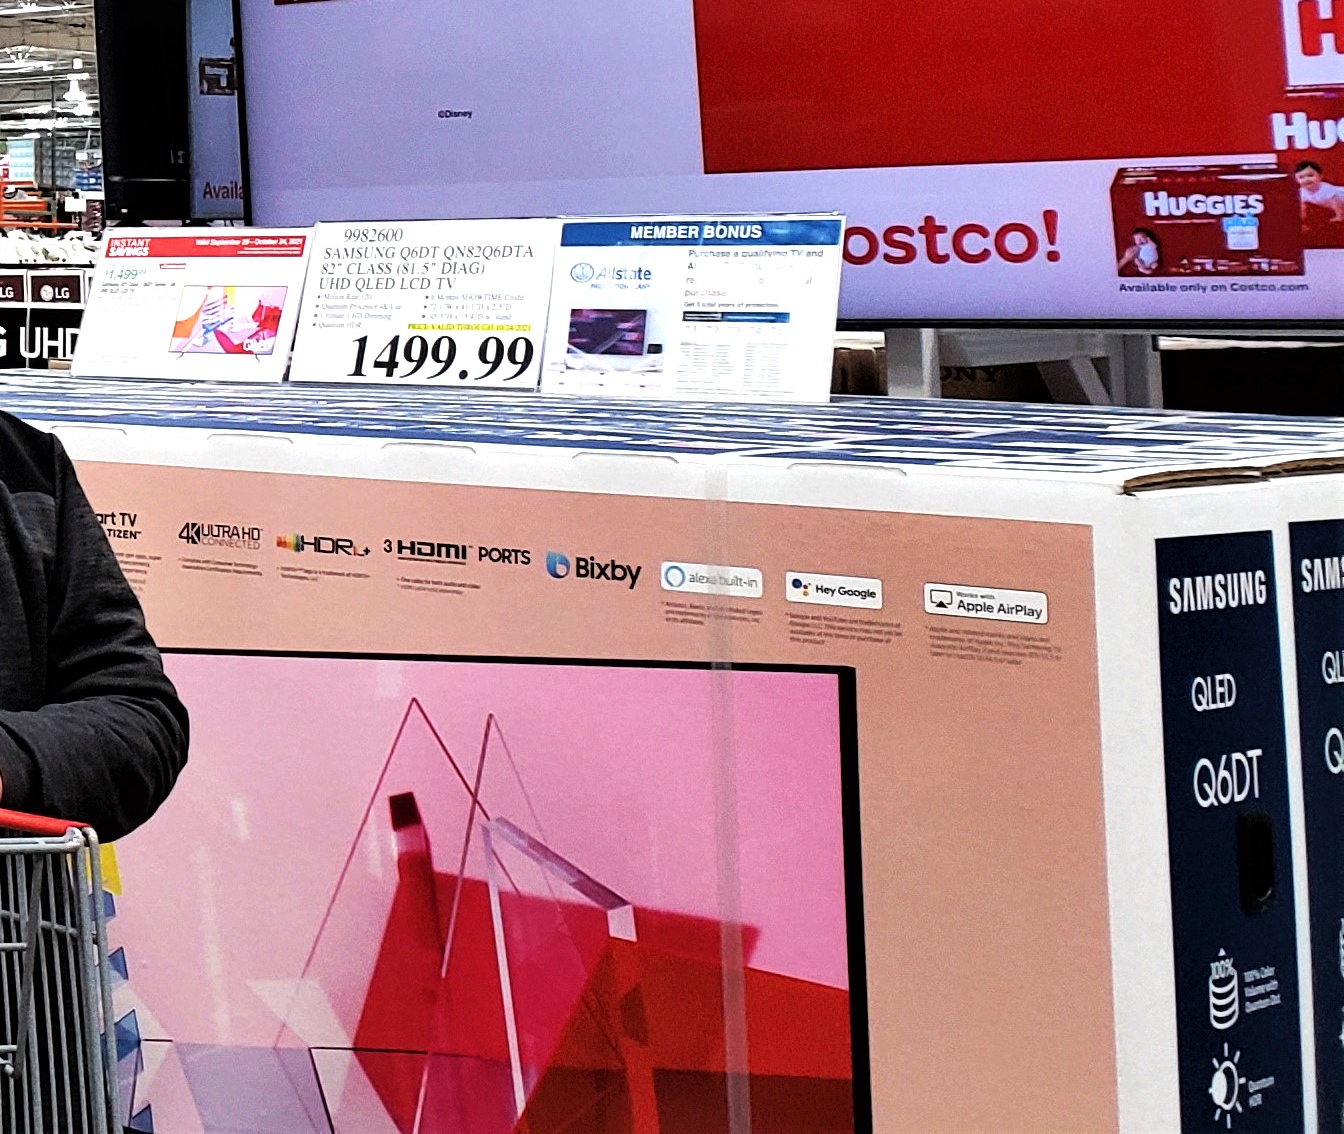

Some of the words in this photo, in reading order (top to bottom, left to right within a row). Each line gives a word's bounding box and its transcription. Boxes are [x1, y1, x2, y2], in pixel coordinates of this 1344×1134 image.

[203, 182, 243, 200] Availa
[1143, 191, 1264, 217] HUGGIES
[344, 229, 403, 242] 9982600
[630, 225, 699, 239] MEMBER
[703, 225, 762, 239] BONUS
[842, 209, 1061, 265] ostco!
[111, 239, 151, 247] INSTANT
[109, 247, 150, 257] SAVINGS
[324, 247, 395, 259] SAMSUNG
[400, 247, 439, 259] Q6DT
[444, 246, 534, 260] QN82Q6DTA
[688, 250, 731, 258] Purchase
[321, 263, 343, 275] 82"
[346, 263, 393, 274] CLASS
[396, 263, 436, 275] (81.5"
[441, 262, 485, 275] DIAG)
[596, 267, 652, 280] Allstate
[319, 278, 350, 290] UHD
[355, 278, 395, 291] QLED
[400, 278, 431, 290] LCD
[436, 278, 456, 290] TV
[1119, 282, 1177, 293] Available
[1180, 283, 1208, 295] only
[1211, 284, 1229, 293] on
[0, 286, 14, 298] LG
[55, 287, 70, 299] LG
[347, 335, 534, 381] 1499.99
[95, 513, 116, 526] art
[119, 514, 137, 527] TV
[178, 523, 201, 544] 4K
[201, 523, 240, 539] ULTRA
[242, 527, 261, 541] HD
[201, 538, 260, 550] CONNECTED
[383, 539, 394, 554] 3
[397, 540, 467, 560] HDMI
[478, 547, 531, 565] PORTS
[575, 556, 642, 589] Bixby
[689, 572, 717, 585] alexa
[719, 573, 759, 589] built-in
[815, 584, 836, 599] Hey
[838, 587, 877, 602] Google
[1169, 570, 1267, 614] SAMSUNG
[957, 600, 994, 615] Apple
[997, 602, 1043, 619] AirPlay
[1191, 673, 1238, 712] QLED
[1193, 748, 1264, 808] Q6DT
